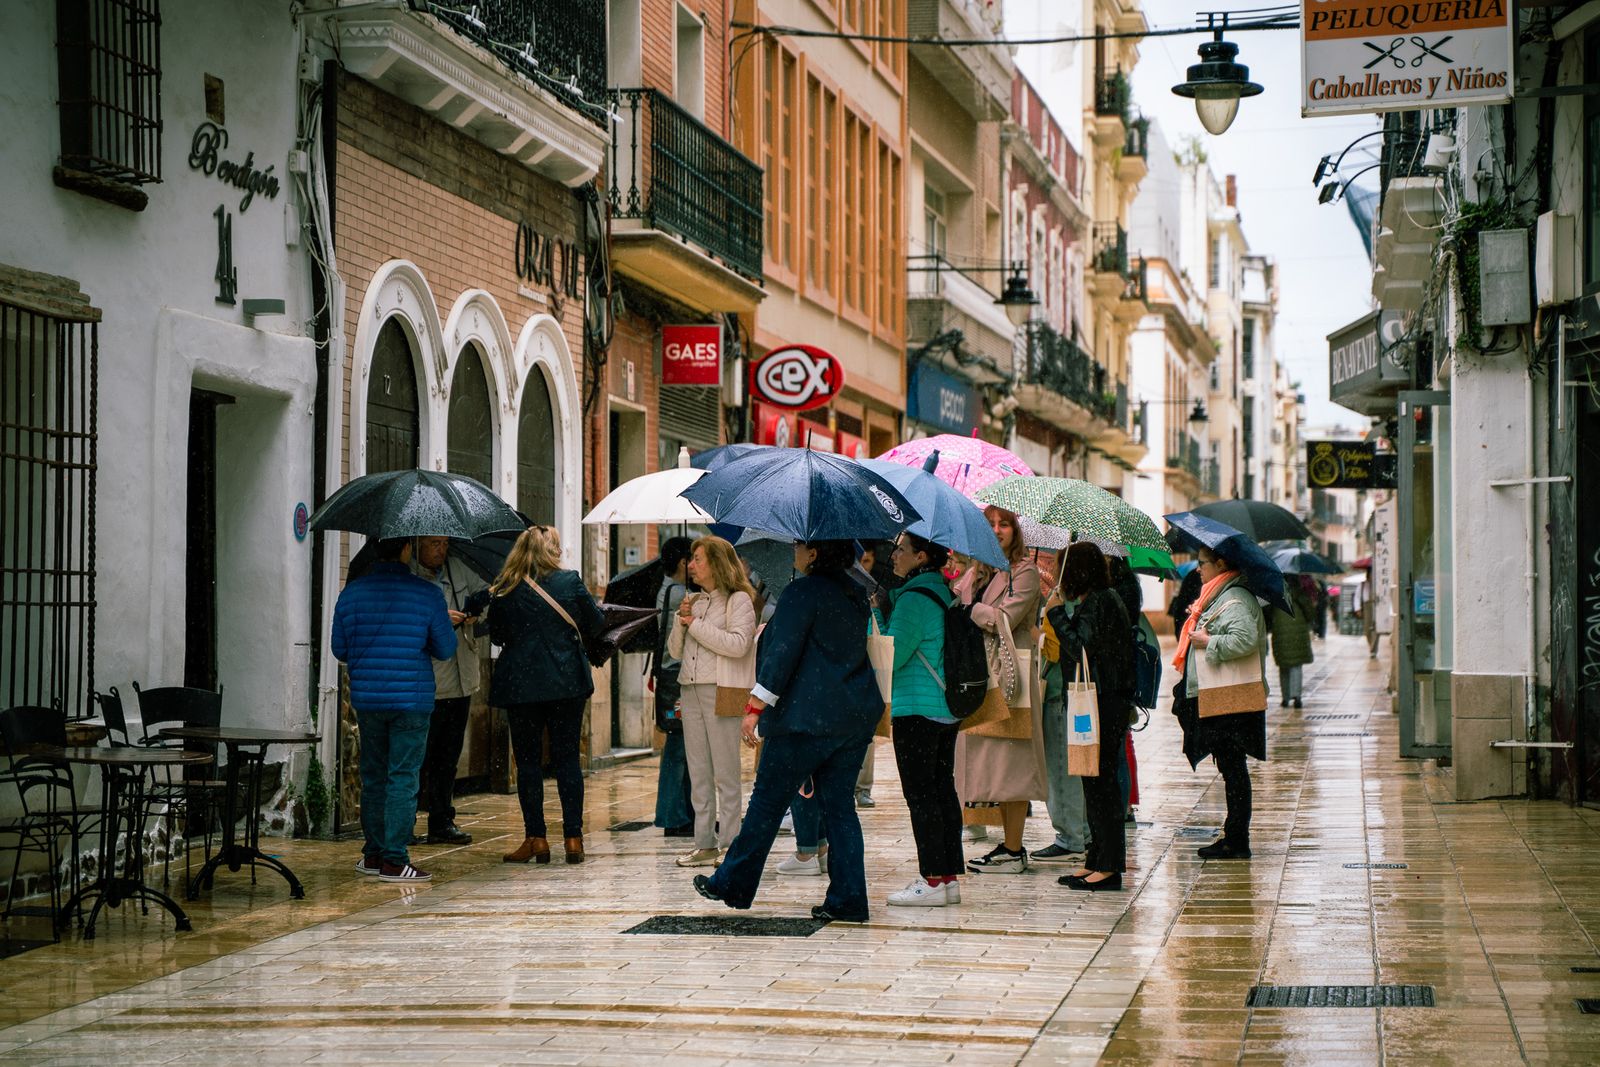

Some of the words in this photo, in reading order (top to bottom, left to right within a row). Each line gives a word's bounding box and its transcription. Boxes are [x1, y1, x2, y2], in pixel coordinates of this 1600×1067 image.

[1308, 73, 1422, 100] Caballeros
[1425, 76, 1441, 99] y
[1446, 67, 1508, 92] Niños
[665, 343, 717, 361] GAES
